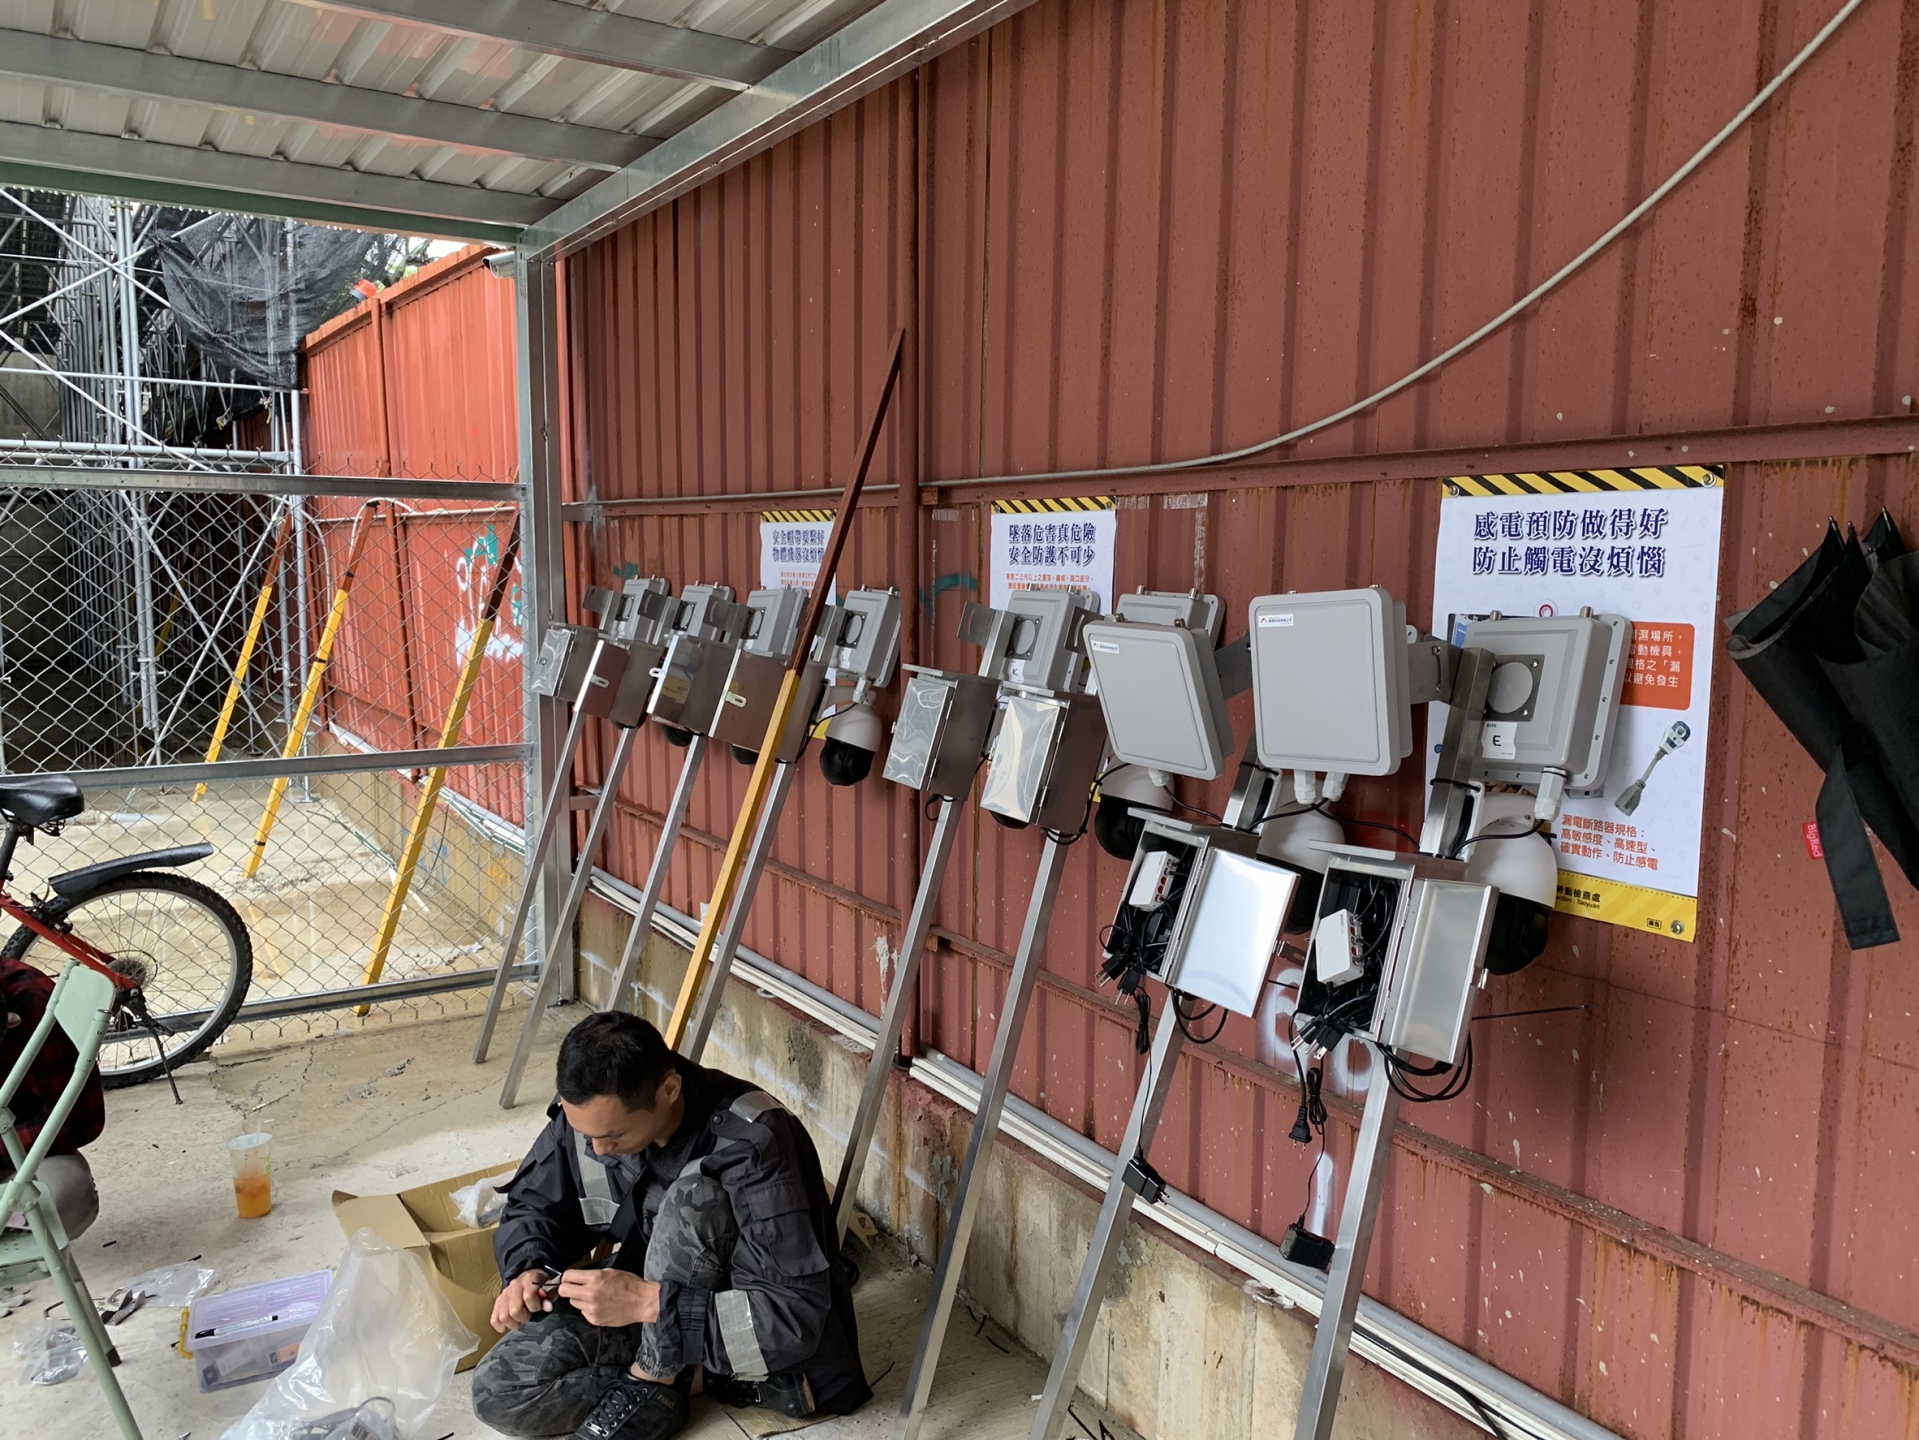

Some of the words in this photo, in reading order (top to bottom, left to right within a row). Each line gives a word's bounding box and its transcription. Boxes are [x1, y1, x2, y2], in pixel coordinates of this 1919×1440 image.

[1008, 522, 1096, 544] 墜落危害真危險
[1473, 507, 1669, 540] 感電預防做得好
[1008, 545, 1096, 567] 安全防護不可少
[1472, 545, 1666, 577] 防止觸電沒煩惱
[1492, 735, 1502, 746] E
[1561, 814, 1645, 838] 漏電斷路器規格：
[1561, 828, 1656, 854] 高敏感度、高速型、
[1560, 842, 1659, 871] 確實動作、防止感電
[1577, 899, 1600, 909] Taoyuan
